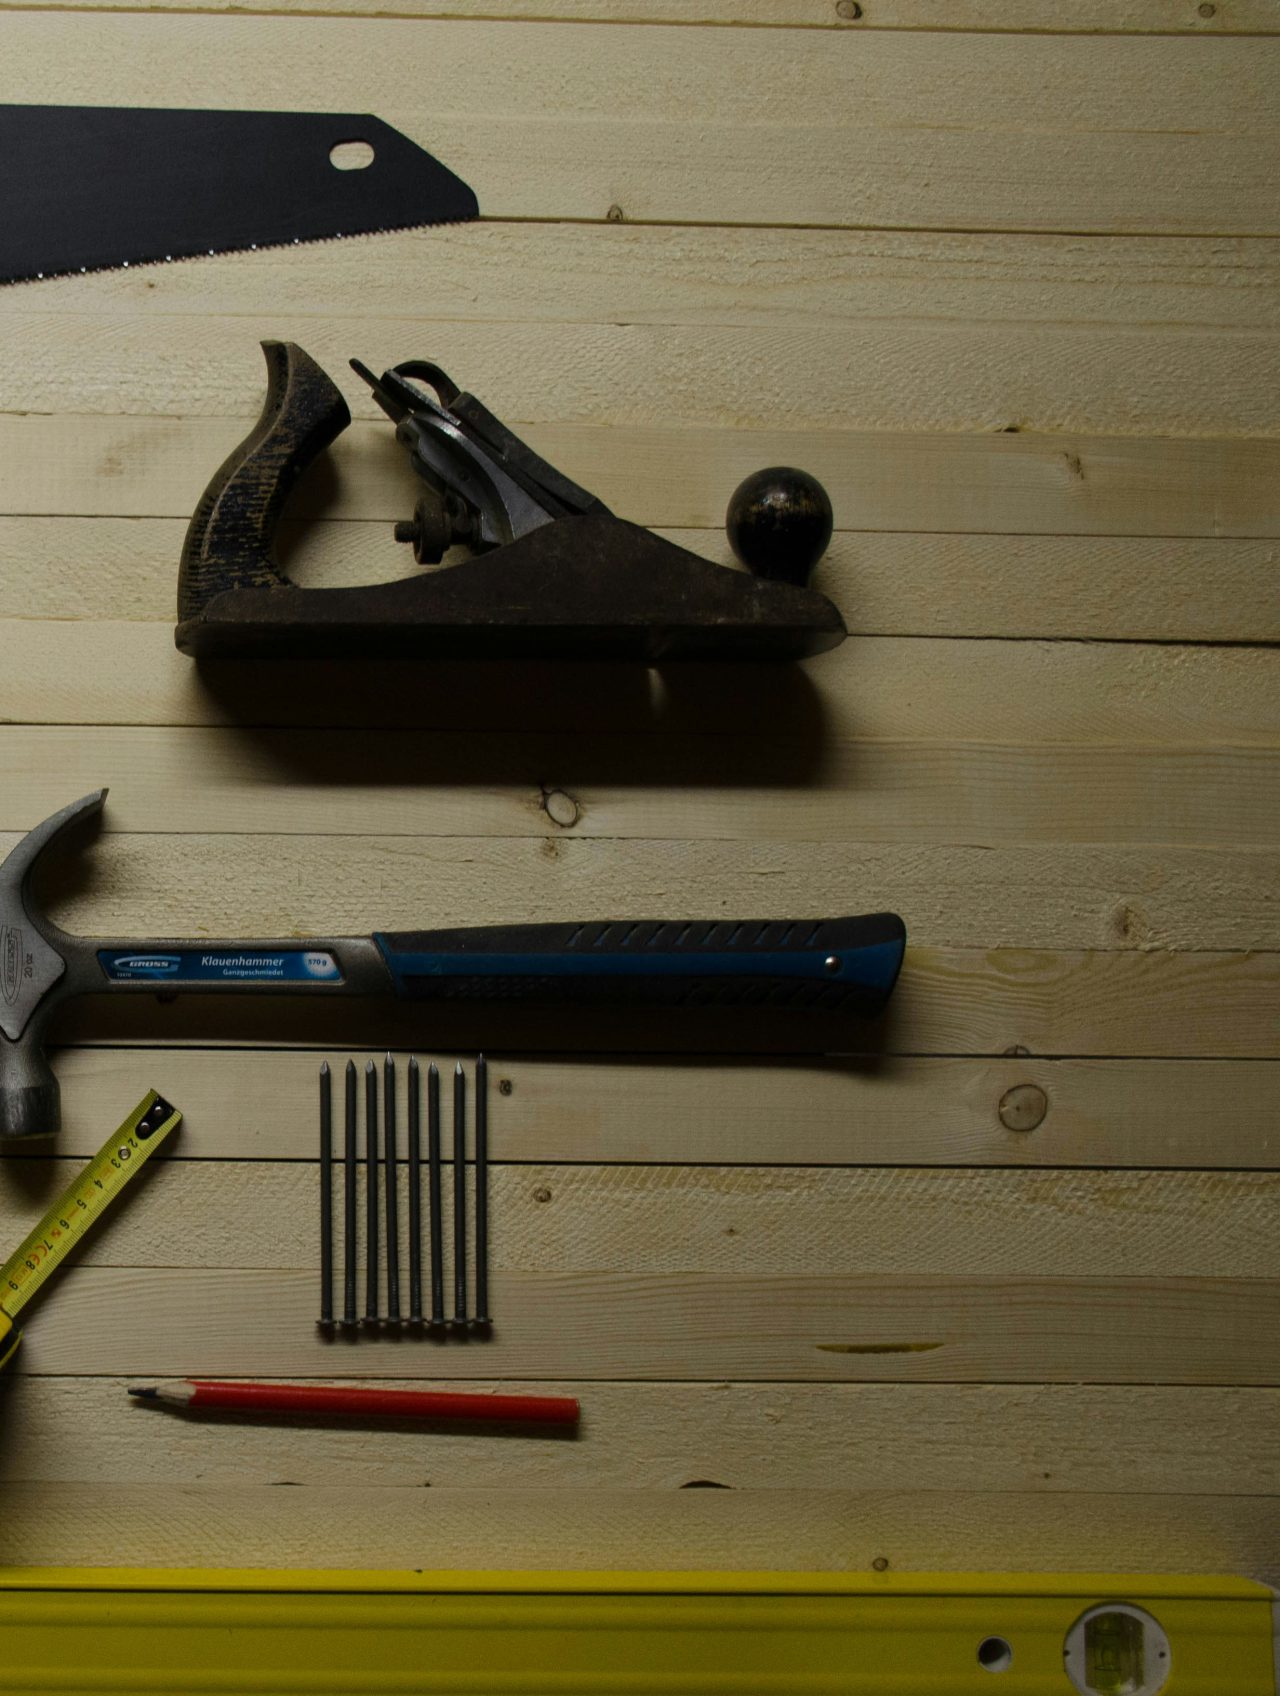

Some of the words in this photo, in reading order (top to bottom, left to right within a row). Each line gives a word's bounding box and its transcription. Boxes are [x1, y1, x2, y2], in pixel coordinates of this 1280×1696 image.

[26, 953, 33, 965] oz
[201, 955, 285, 968] Klauenhammer
[24, 965, 33, 979] 20
[222, 968, 284, 977] Ganzgeschmiedet
[127, 1137, 139, 1149] 2
[110, 1158, 121, 1169] 3
[94, 1179, 104, 1190] 4
[76, 1199, 88, 1210] 5
[59, 1218, 71, 1230] 6
[43, 1239, 54, 1251] 7
[25, 1259, 37, 1271] 8
[8, 1280, 20, 1291] 9
